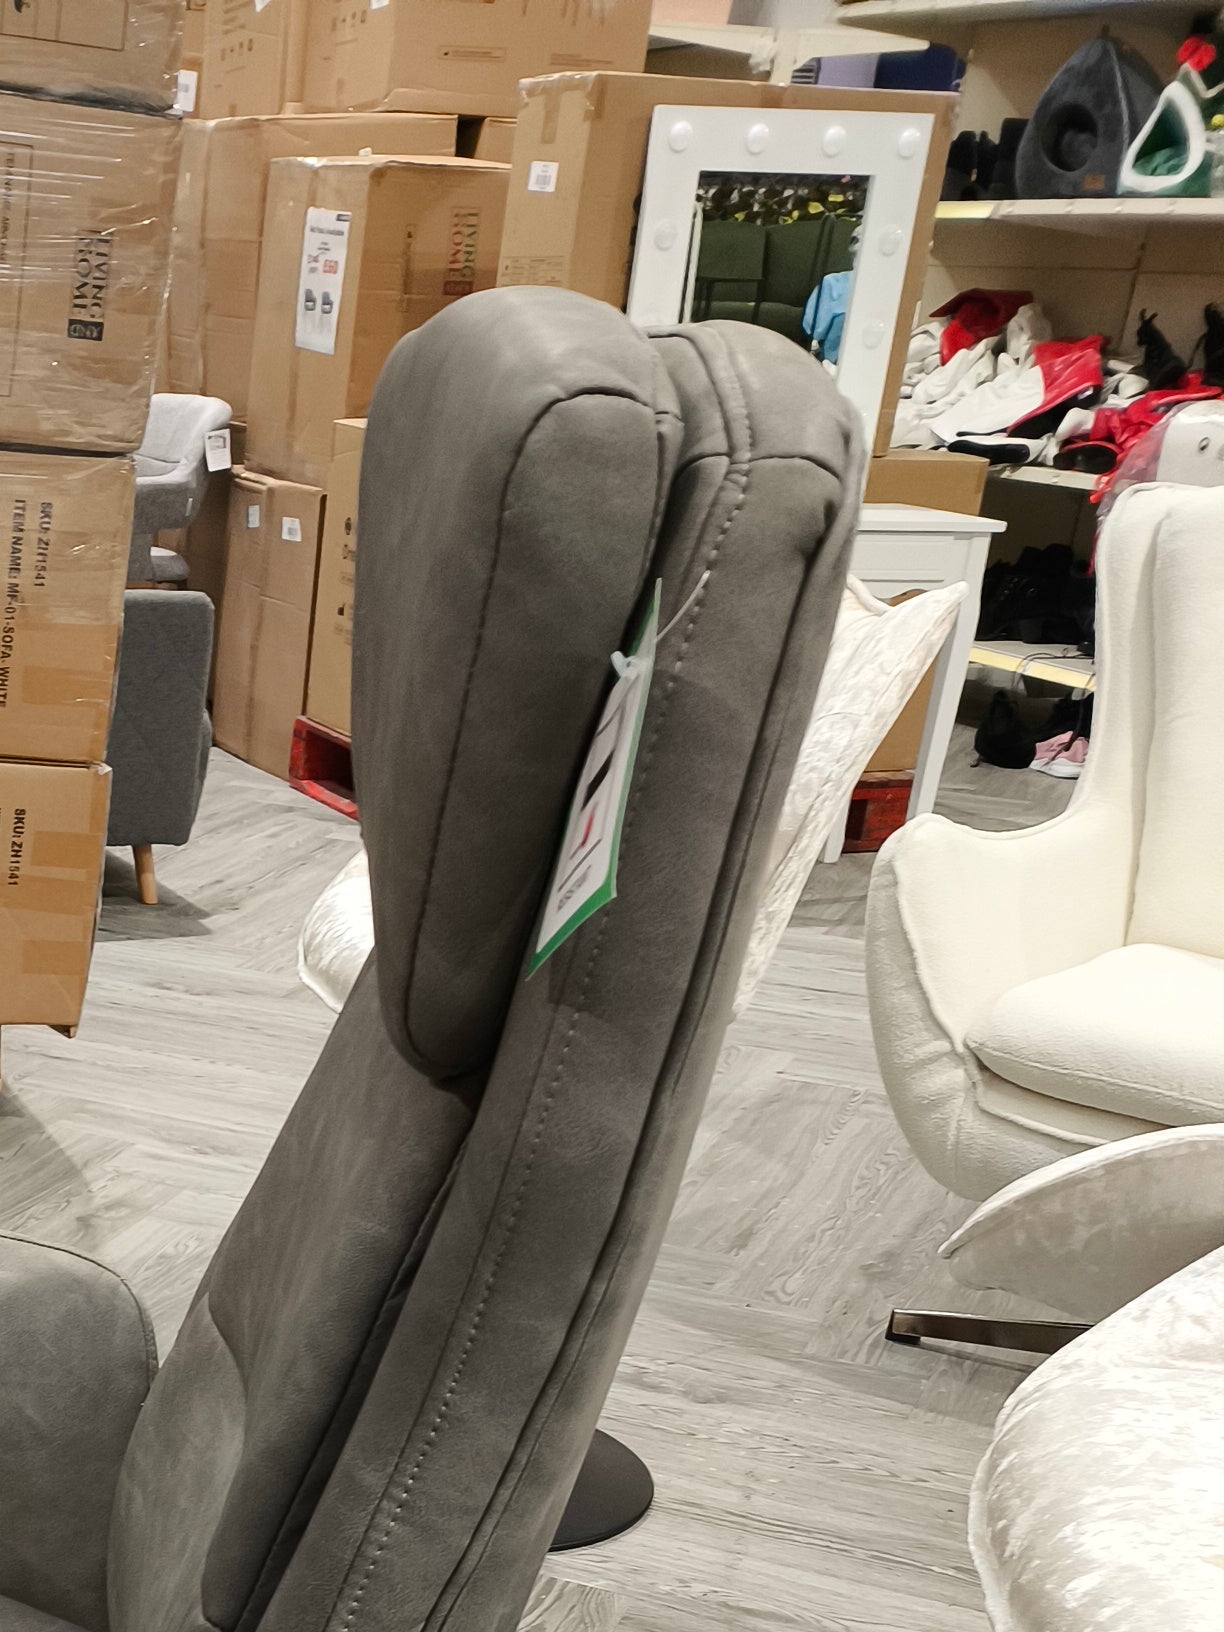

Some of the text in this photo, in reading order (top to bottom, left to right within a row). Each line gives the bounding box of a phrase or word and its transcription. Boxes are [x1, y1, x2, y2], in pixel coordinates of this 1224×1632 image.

[91, 238, 111, 319] LIVING
[13, 499, 26, 533] ITEM
[12, 808, 26, 839] SKU:
